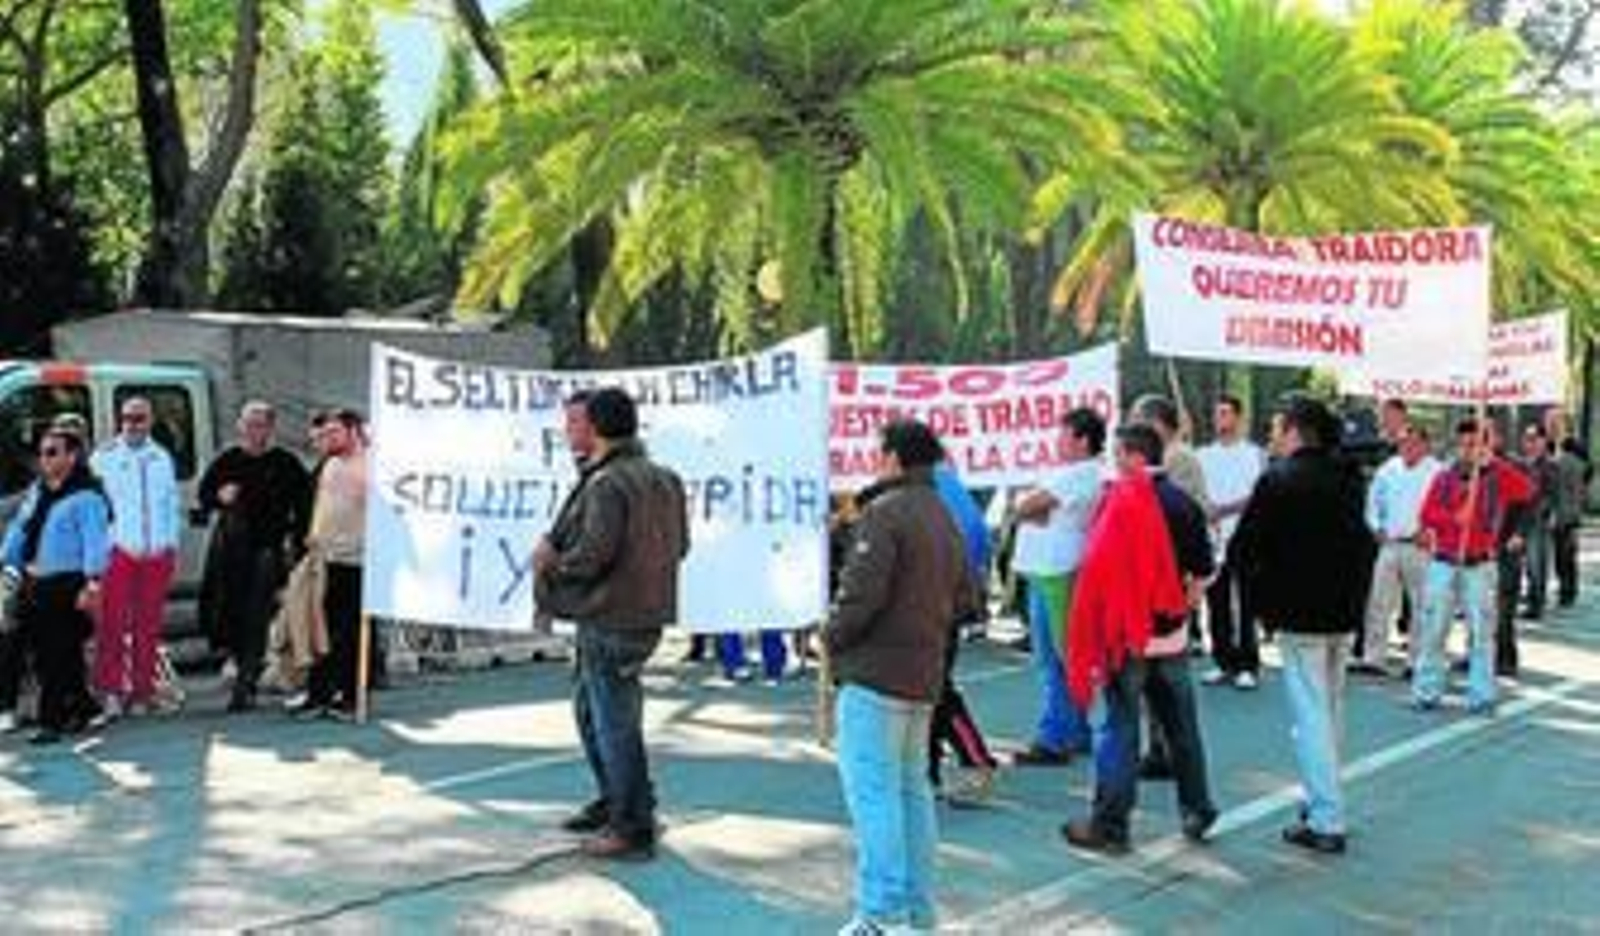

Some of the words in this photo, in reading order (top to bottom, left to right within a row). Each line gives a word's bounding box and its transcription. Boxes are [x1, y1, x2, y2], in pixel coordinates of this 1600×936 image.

[1192, 264, 1357, 304] QUEREMOS
[1367, 275, 1408, 309] TU
[928, 403, 969, 437] DE
[967, 445, 1005, 471] LA
